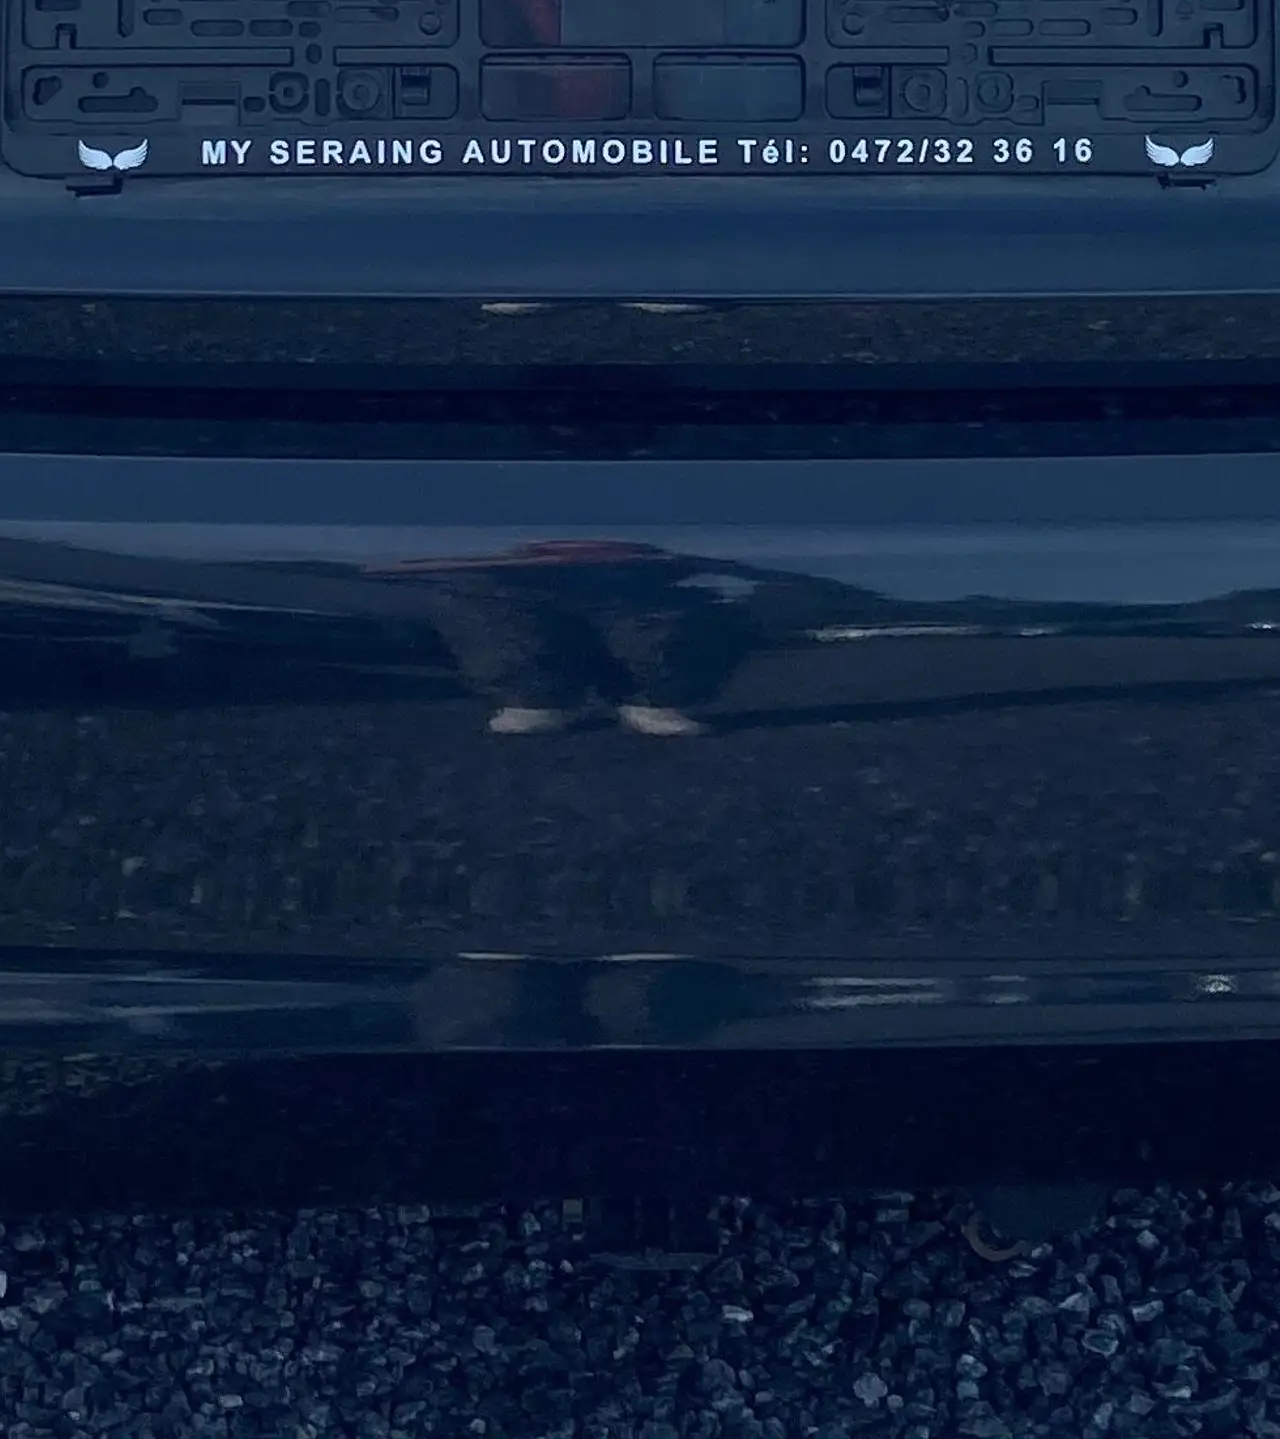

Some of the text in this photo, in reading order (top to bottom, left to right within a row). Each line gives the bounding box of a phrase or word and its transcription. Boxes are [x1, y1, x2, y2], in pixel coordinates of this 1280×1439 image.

[202, 137, 1093, 164] MY SERAING AUTOMOBILE Tél: 0472/32 36 16
